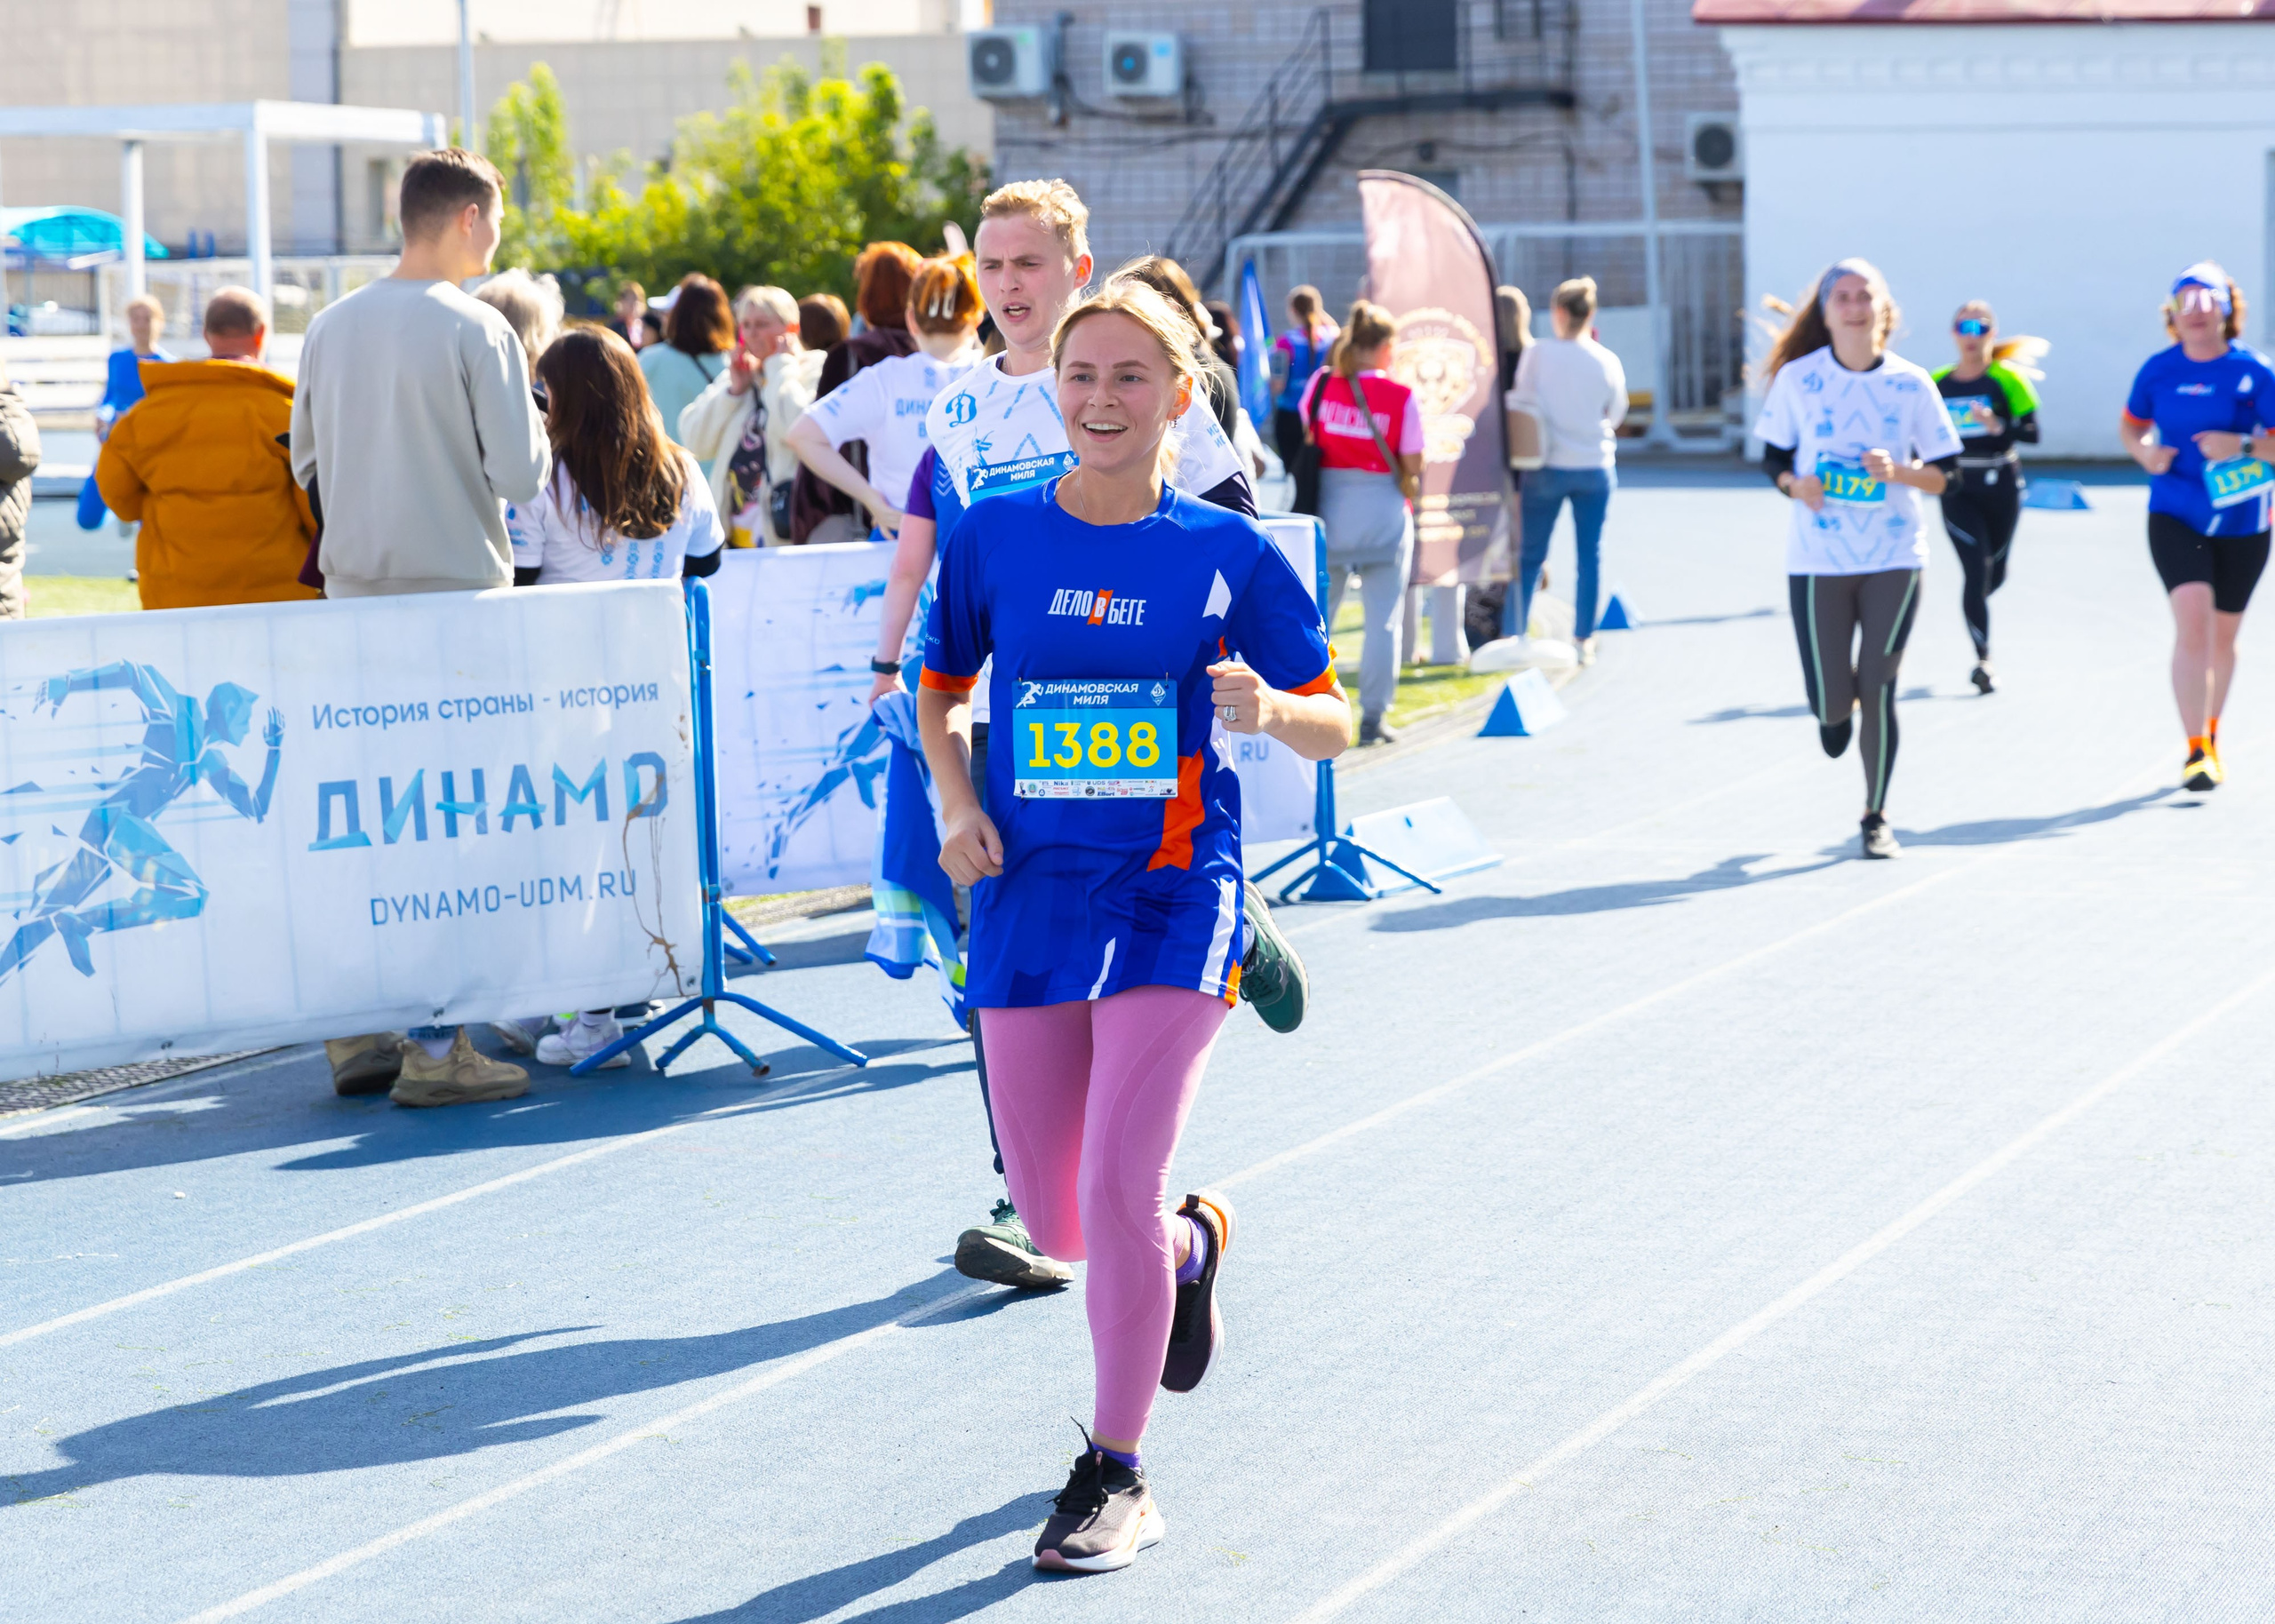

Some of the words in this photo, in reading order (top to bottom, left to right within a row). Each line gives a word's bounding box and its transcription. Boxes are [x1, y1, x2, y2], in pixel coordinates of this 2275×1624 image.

[989, 457, 1055, 477] ДИНАМОВСКАЯ
[1010, 469, 1036, 482] МИЛЯ
[1823, 471, 1877, 497] 1179
[1047, 588, 1094, 617] ДЕЛО
[1106, 598, 1147, 625] БЕГЕ
[1045, 683, 1139, 695] ДИНАМОВСКАЯ
[1073, 695, 1109, 705] МИЛЯ
[312, 702, 430, 730] История
[437, 692, 534, 722] страны
[559, 682, 659, 710] история
[1028, 721, 1161, 768] 1388
[307, 752, 668, 852] ДИНАМО
[371, 870, 636, 926] DYNAMO-UDM.RU
